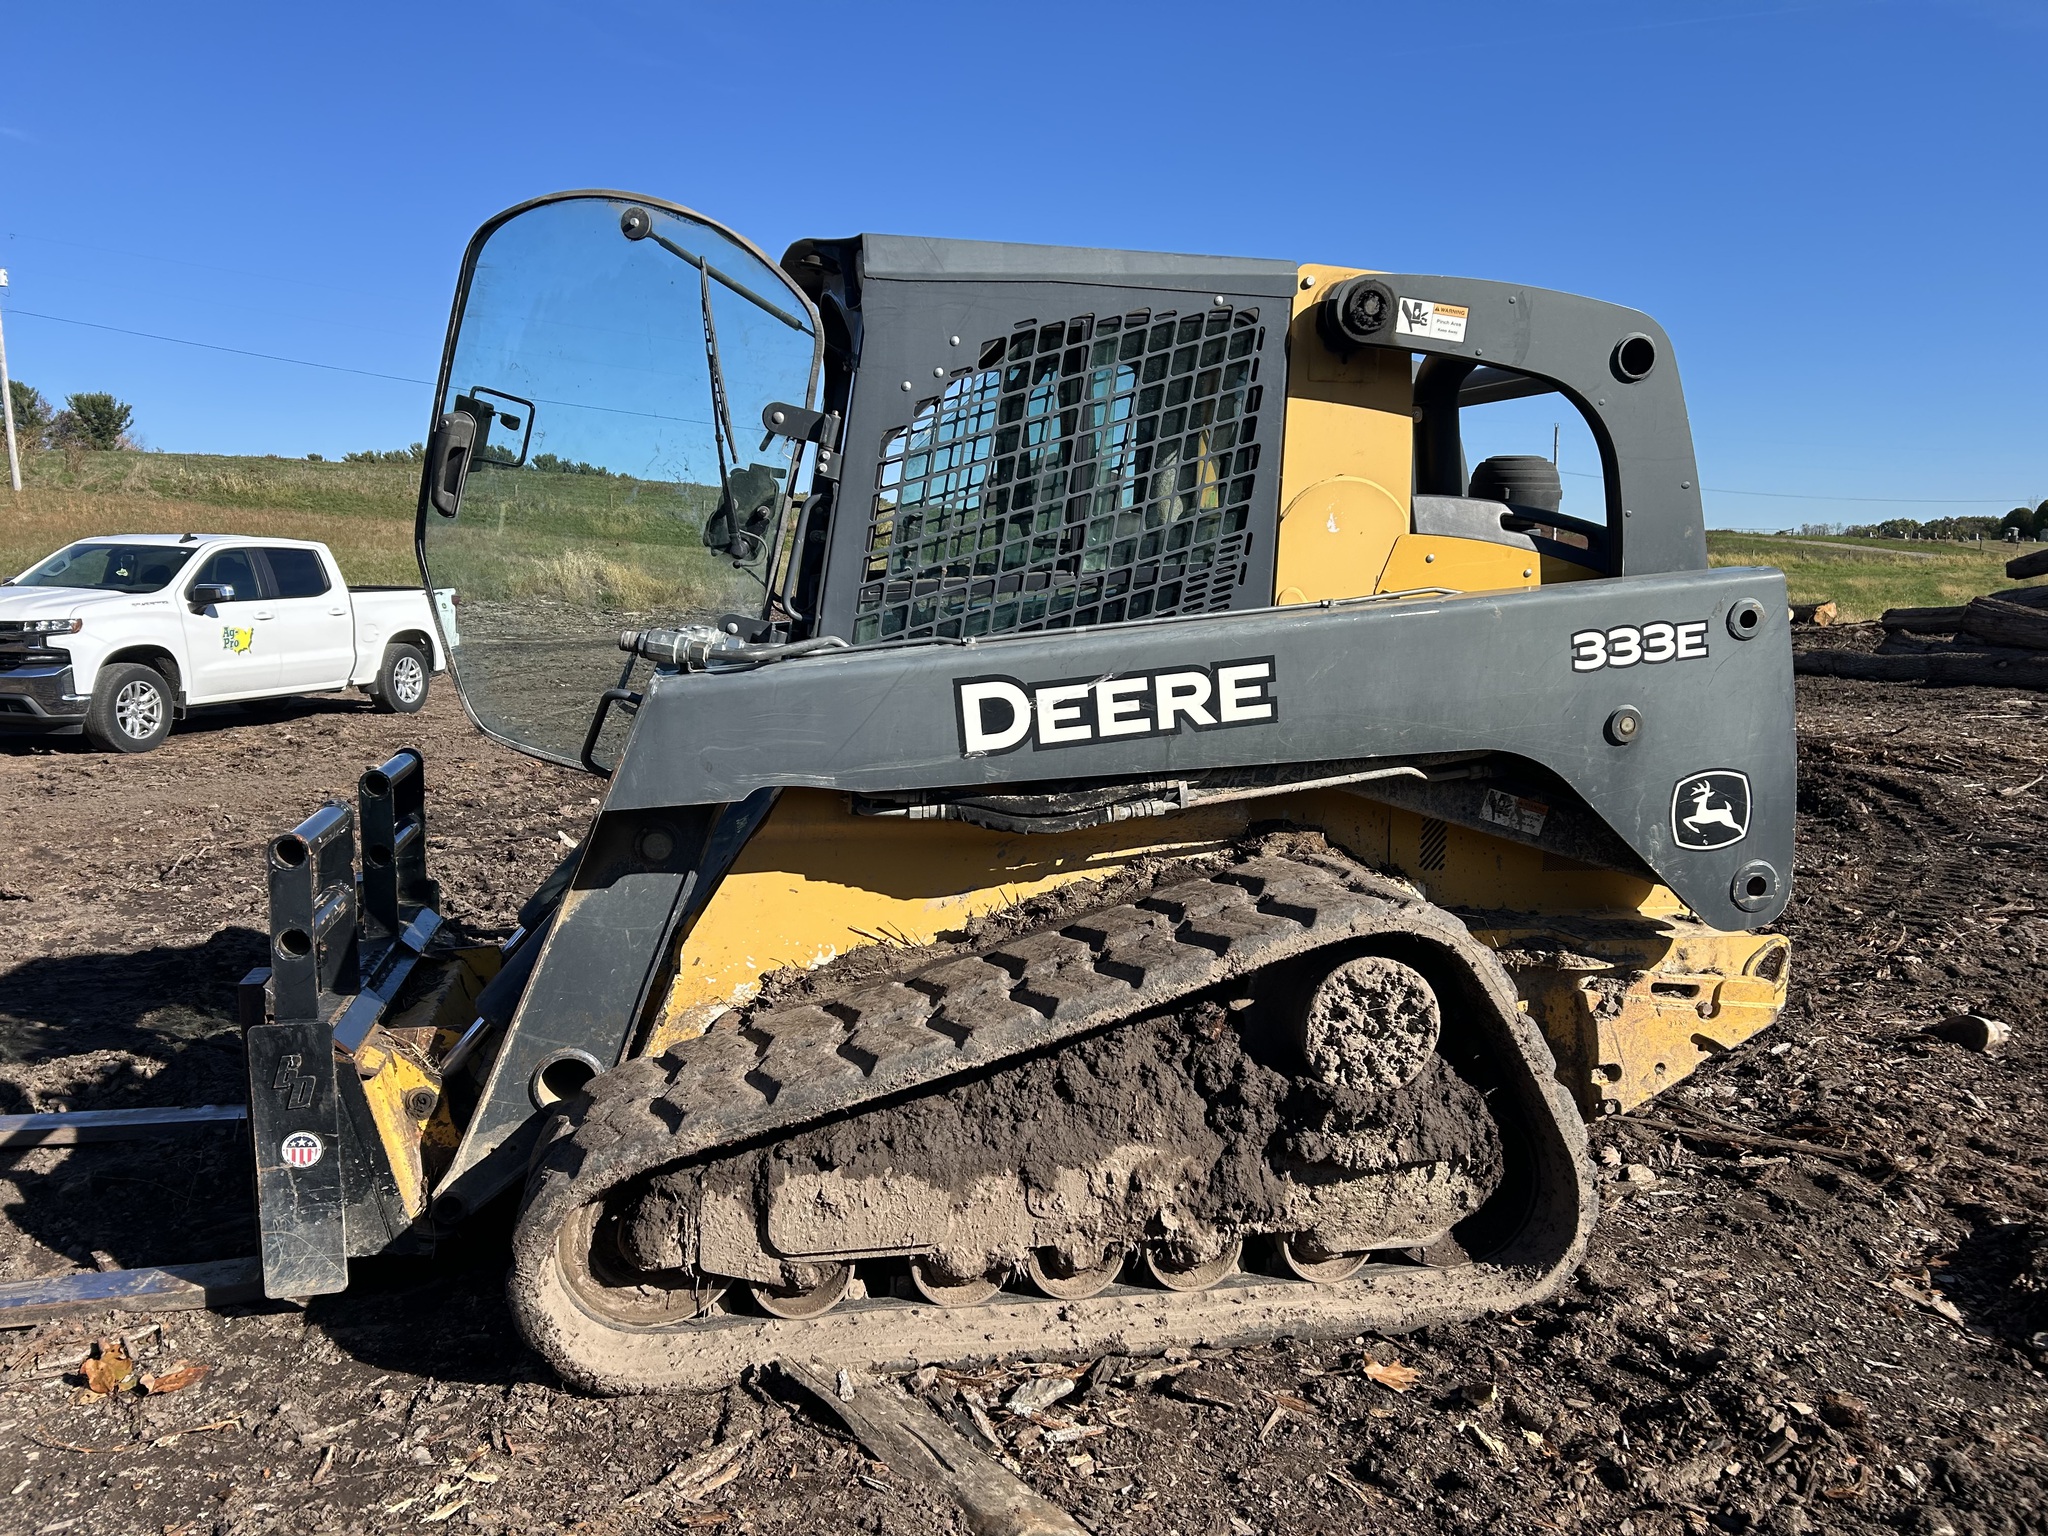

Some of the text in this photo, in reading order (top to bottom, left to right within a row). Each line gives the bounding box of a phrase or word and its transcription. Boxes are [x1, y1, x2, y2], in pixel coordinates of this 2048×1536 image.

[1440, 307, 1466, 316] WARNING
[223, 638, 240, 649] Pro
[1571, 620, 1708, 672] 333E
[957, 660, 1275, 754] DEERE
